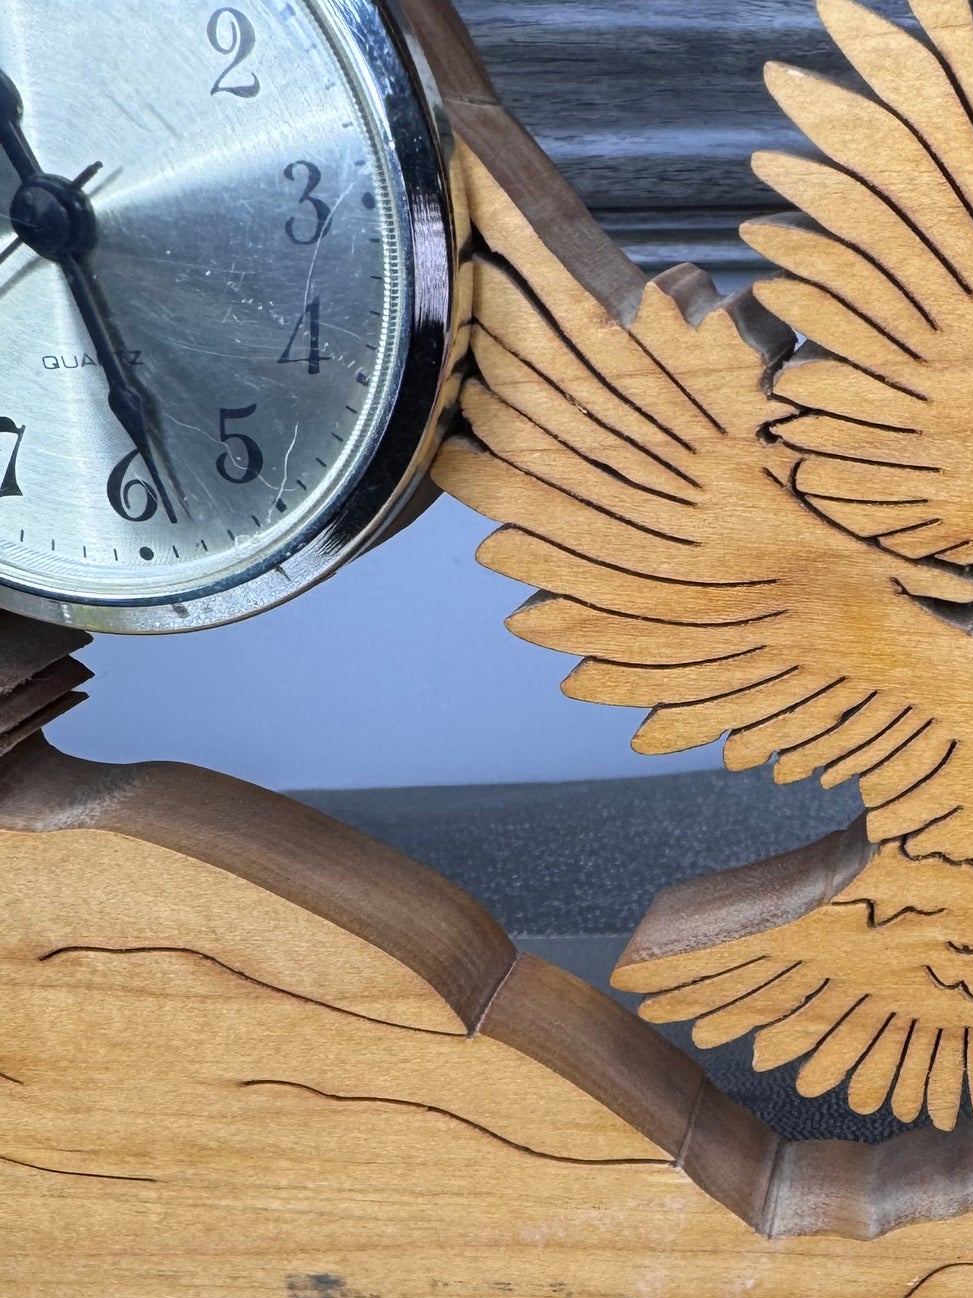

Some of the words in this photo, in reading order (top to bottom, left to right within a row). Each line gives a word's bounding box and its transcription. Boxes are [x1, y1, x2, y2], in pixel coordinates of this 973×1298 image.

[206, 7, 260, 98] 2
[283, 160, 333, 245] 3
[42, 350, 144, 370] QUAZ
[277, 296, 330, 375] 4
[0, 416, 26, 497] 7
[216, 403, 264, 484] 5
[107, 448, 157, 521] 6
